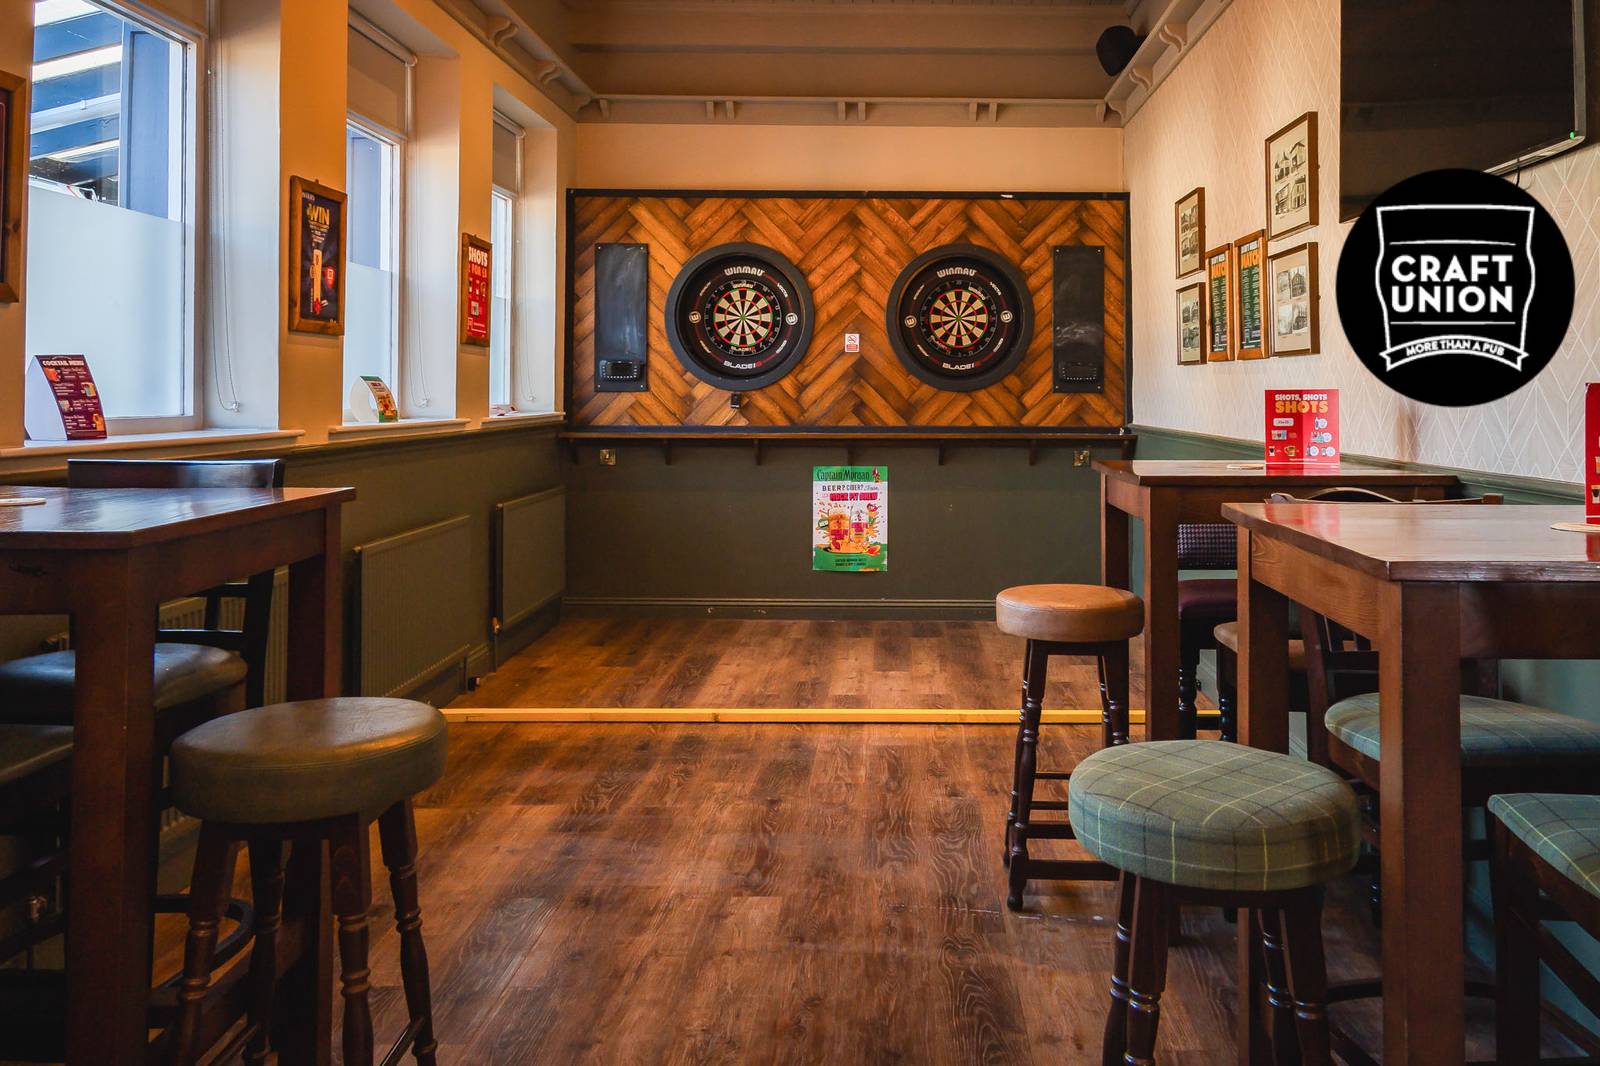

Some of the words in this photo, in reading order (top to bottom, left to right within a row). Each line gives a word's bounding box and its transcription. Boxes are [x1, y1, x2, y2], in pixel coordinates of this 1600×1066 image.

[310, 205, 330, 226] WIN
[468, 246, 488, 267] SHOTS
[724, 266, 766, 276] WINMAU
[936, 266, 977, 278] WINMAU
[1275, 401, 1329, 413] SHOTS
[816, 470, 842, 481] Captain
[842, 470, 870, 482] Morgan
